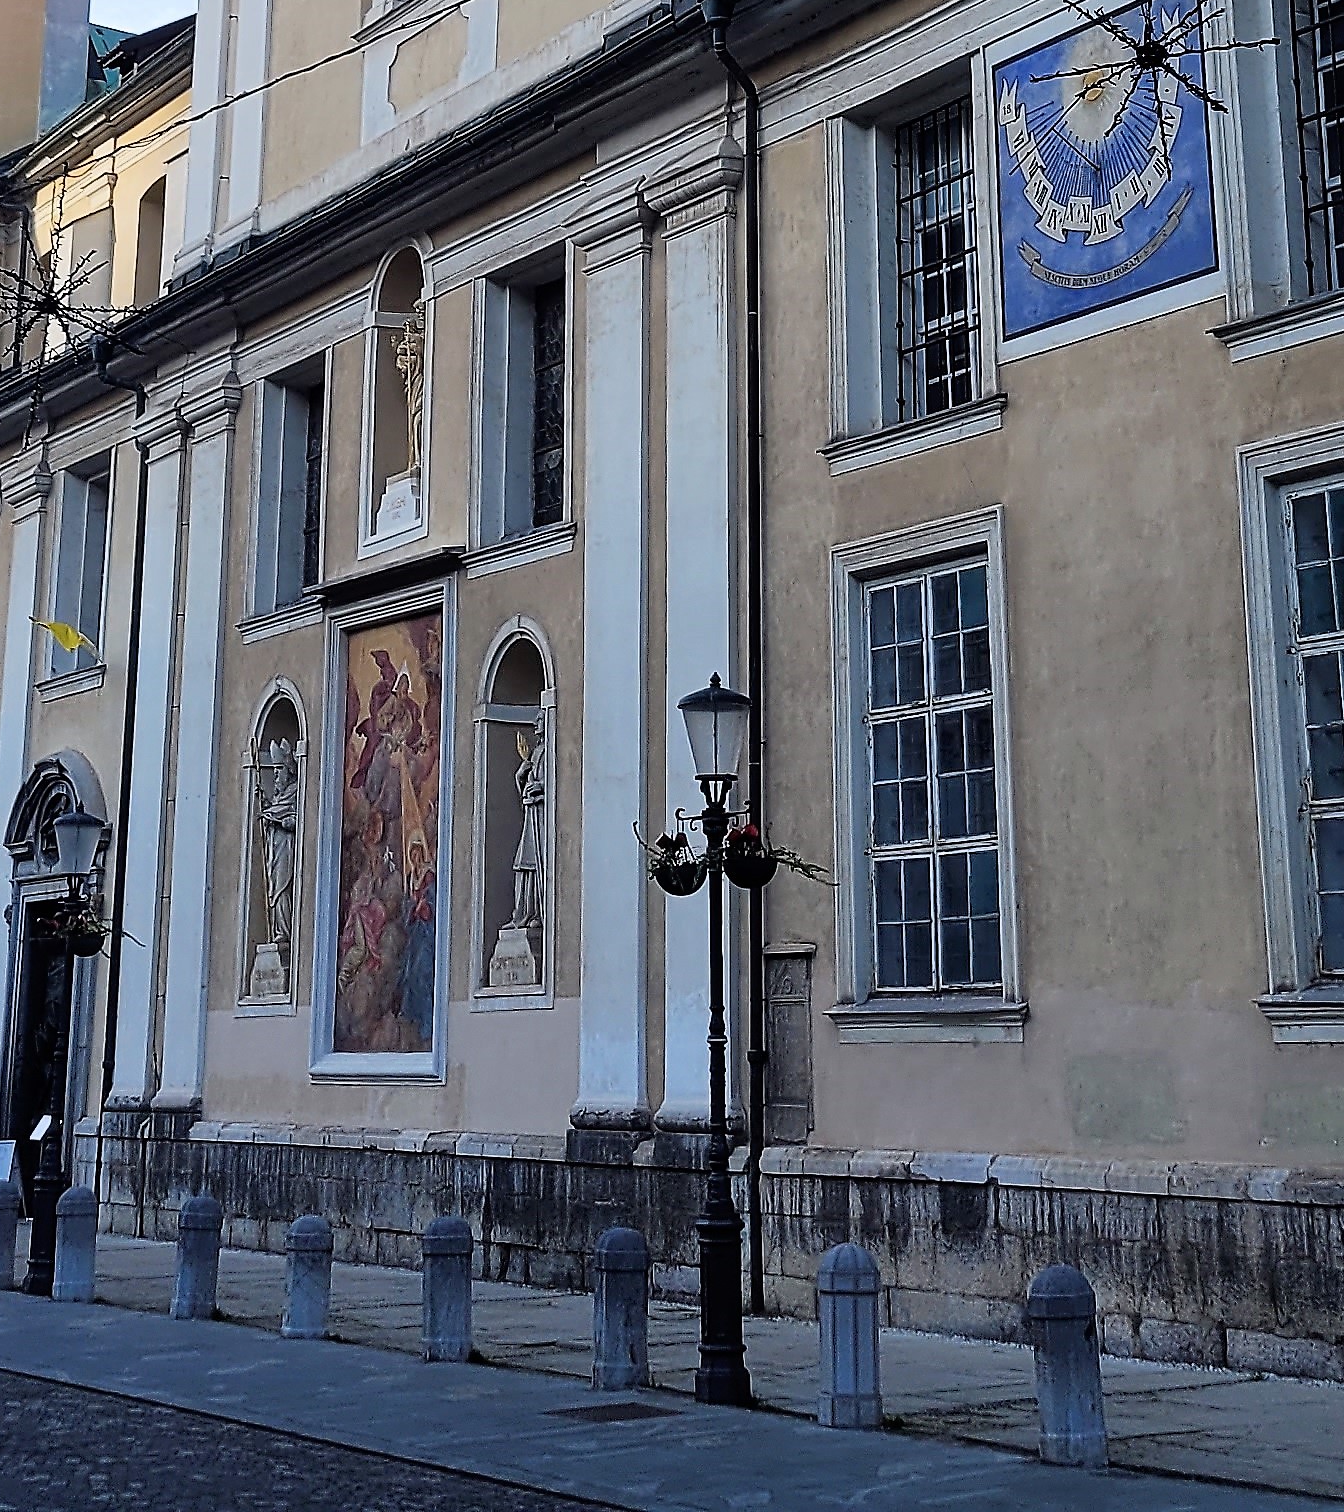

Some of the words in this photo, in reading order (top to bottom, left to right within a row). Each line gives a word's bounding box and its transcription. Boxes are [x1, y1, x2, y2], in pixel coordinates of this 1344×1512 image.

[1067, 203, 1076, 222] X
[1093, 213, 1107, 235] XII
[1115, 193, 1121, 210] I
[1130, 177, 1140, 195] II
